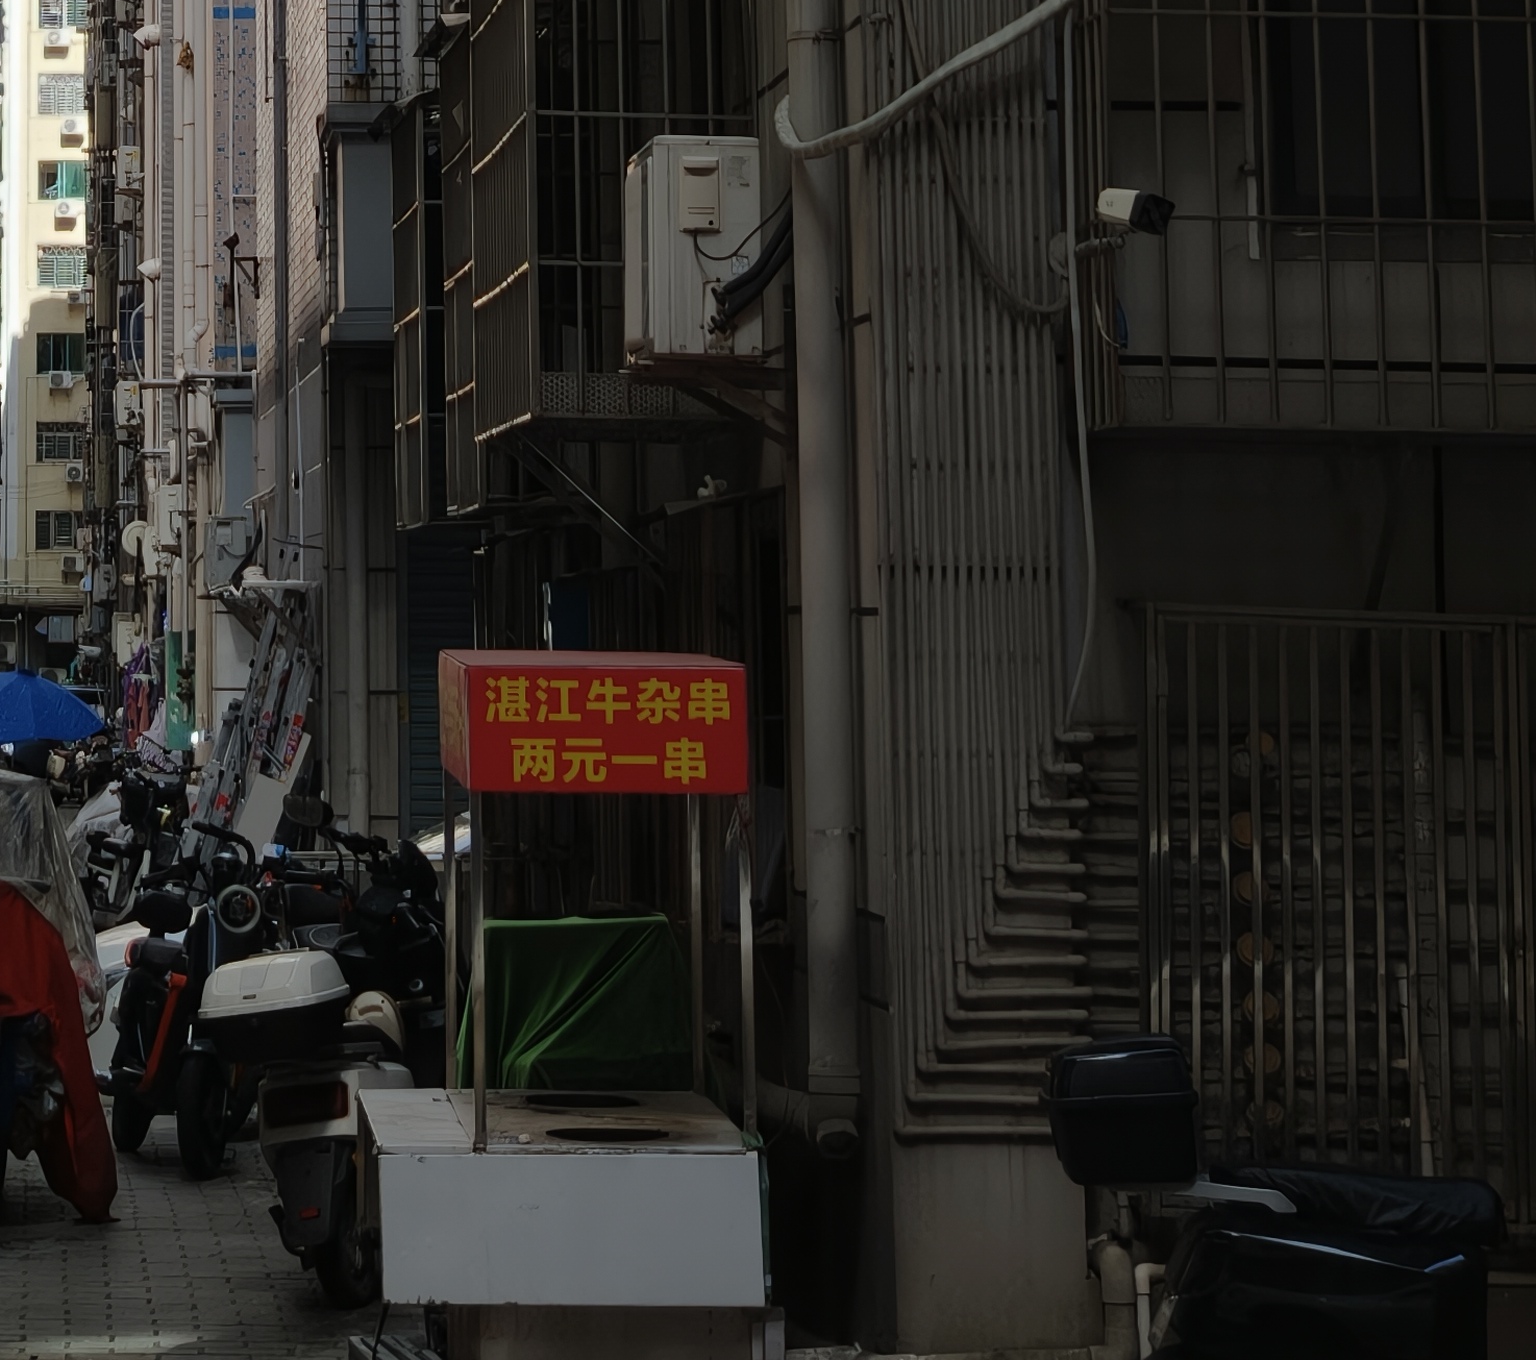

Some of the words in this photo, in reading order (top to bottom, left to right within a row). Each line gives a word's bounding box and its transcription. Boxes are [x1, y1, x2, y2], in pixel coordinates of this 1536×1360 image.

[484, 676, 731, 725] 湛江牛杂串
[510, 736, 708, 785] 两元一串
